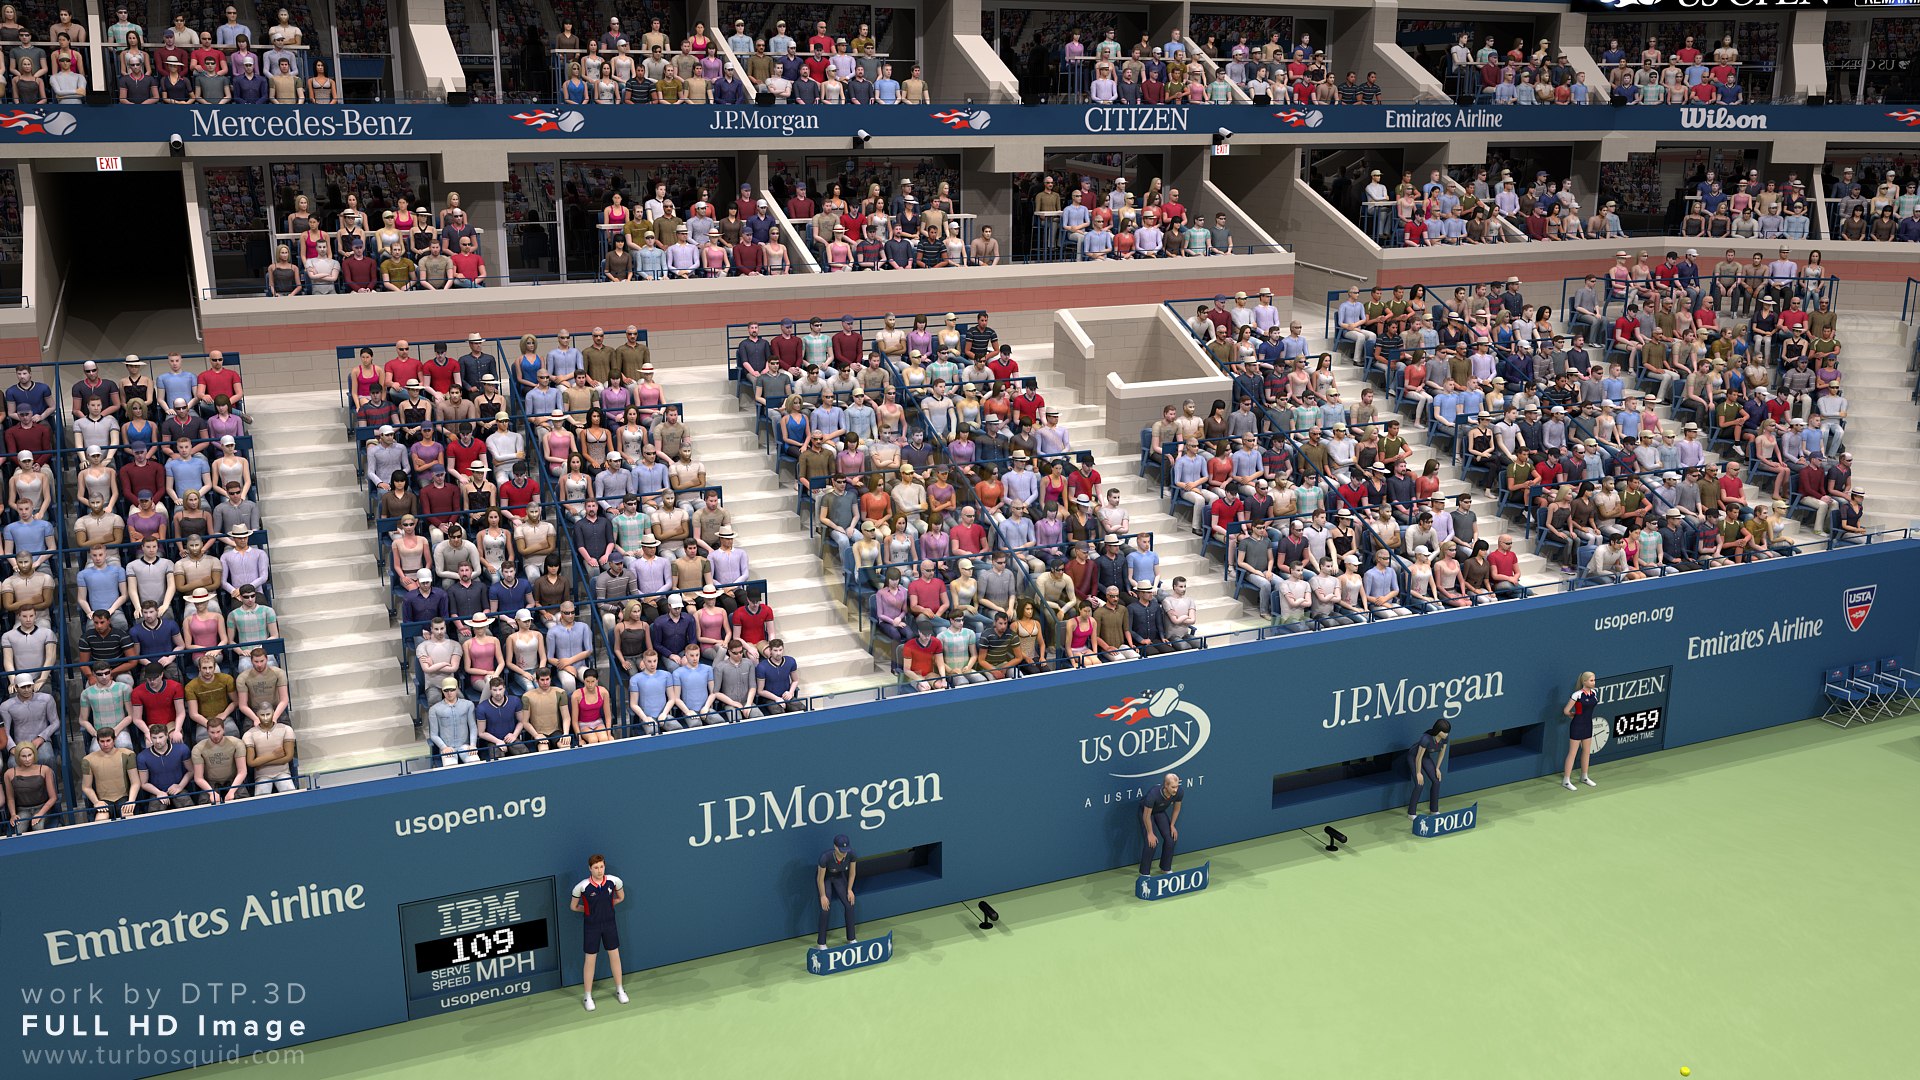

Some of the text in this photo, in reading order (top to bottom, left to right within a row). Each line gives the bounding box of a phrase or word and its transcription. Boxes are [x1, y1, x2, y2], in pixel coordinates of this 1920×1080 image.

[192, 109, 413, 137] Mercedes-Benz
[709, 110, 819, 136] J.P.Morgan
[1085, 107, 1189, 132] CITIZEN
[1385, 109, 1503, 129] Emirates Airline
[1680, 107, 1768, 129] Wilson
[99, 158, 118, 169] EXIT
[1216, 145, 1228, 154] EXIT
[1849, 591, 1872, 603] USTA
[1595, 606, 1674, 630] usopen.org
[1687, 616, 1823, 660] Emirates Airline
[1322, 671, 1504, 728] J.P.Morgan
[1594, 674, 1665, 704] ITIZEN
[1616, 709, 1659, 735] 0:59
[1079, 720, 1193, 764] US OPEN
[1617, 731, 1655, 744] MATCH TIME
[688, 772, 943, 848] J.P.Morgan
[1084, 788, 1143, 808] A USTA
[395, 795, 547, 837] usopen.org
[1433, 810, 1474, 834] POLO
[1156, 869, 1203, 897] POLO
[44, 883, 366, 966] Emirates Airline
[437, 890, 521, 935] IBM
[452, 927, 515, 963] 109
[828, 941, 884, 972] POLO
[431, 950, 535, 982] SERVE MPH
[432, 975, 471, 991] SPEED
[440, 980, 531, 1008] usopen.org
